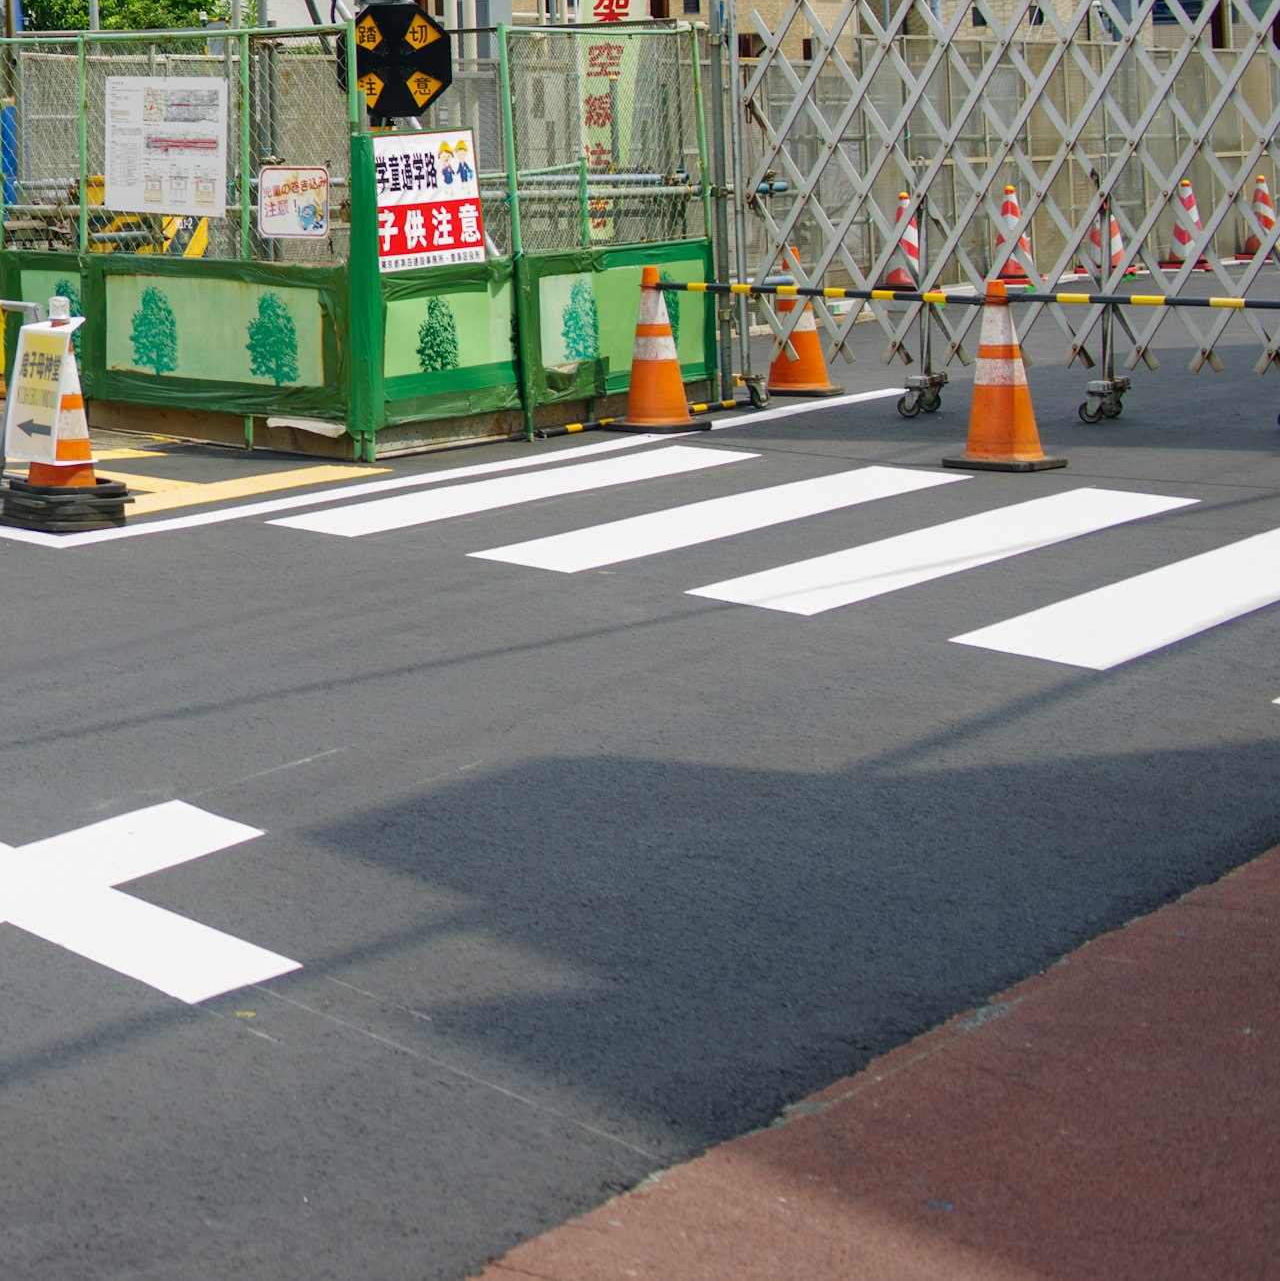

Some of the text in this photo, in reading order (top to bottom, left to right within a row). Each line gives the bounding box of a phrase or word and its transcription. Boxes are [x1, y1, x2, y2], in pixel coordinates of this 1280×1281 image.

[358, 25, 428, 44] 踏切
[359, 77, 431, 96] 注意
[375, 151, 438, 194] 学童通学路
[378, 203, 481, 252] 子供注意
